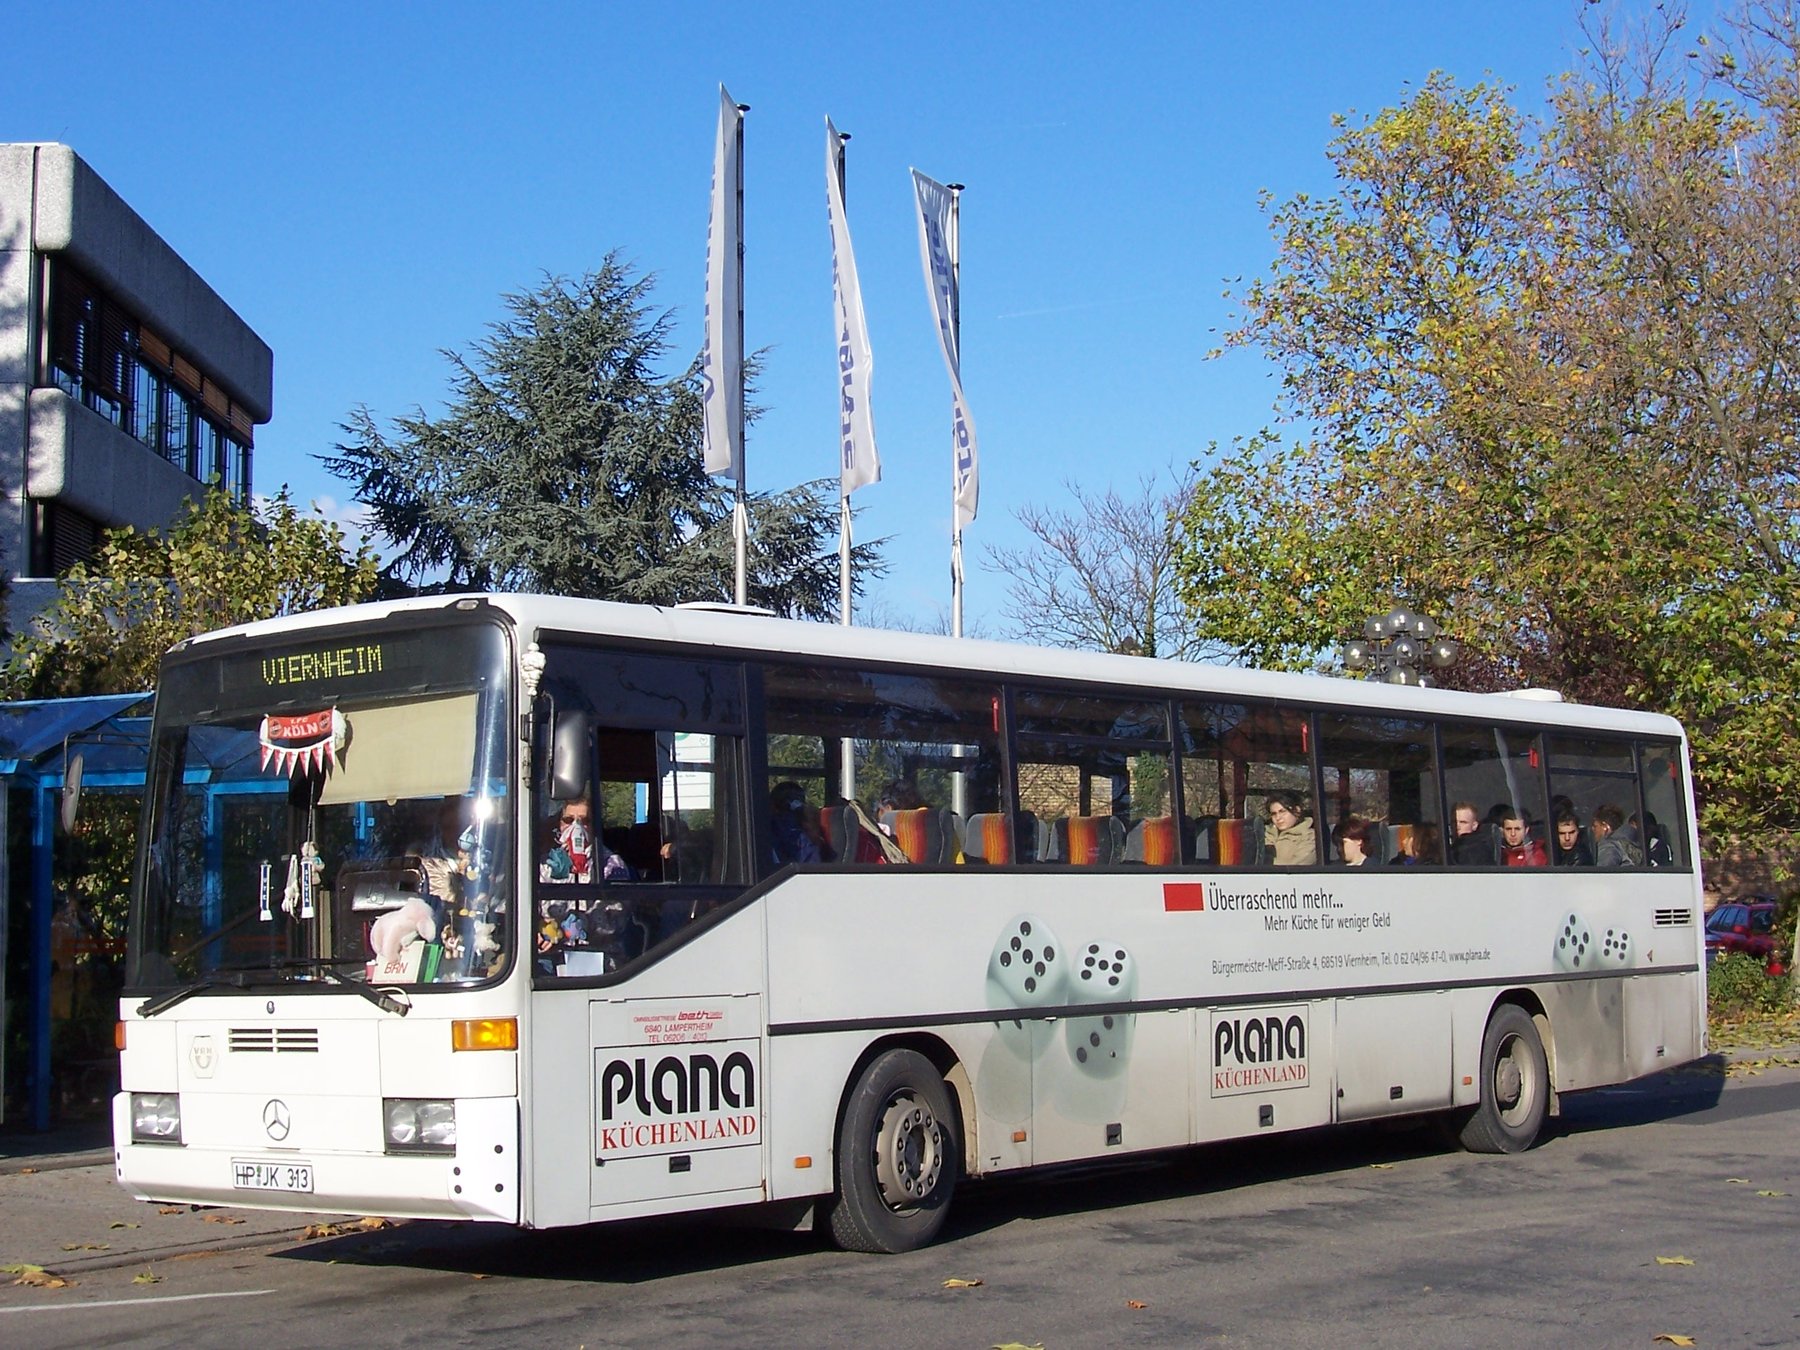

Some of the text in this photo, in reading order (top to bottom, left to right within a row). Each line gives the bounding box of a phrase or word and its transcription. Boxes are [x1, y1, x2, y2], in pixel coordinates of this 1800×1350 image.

[262, 645, 382, 685] VIERNHEIM
[283, 722, 318, 738] KÖLN
[1208, 882, 1344, 911] Überraschend mehr...
[1264, 911, 1391, 933] Mehr Küche für weniger Geld
[384, 962, 408, 974] BRN
[1212, 955, 1311, 978] Bürgermeister-Neff-Straße
[1321, 955, 1343, 969] 68519
[1344, 953, 1380, 968] Viernheim,
[1449, 948, 1491, 964] www.plana.de
[644, 1022, 714, 1034] 6840 LAMPERTHEIM
[1214, 1064, 1307, 1090] KÜCHENLAND
[601, 1115, 757, 1150] KÜCHENLAND
[235, 1165, 310, 1189] HP JK 313
